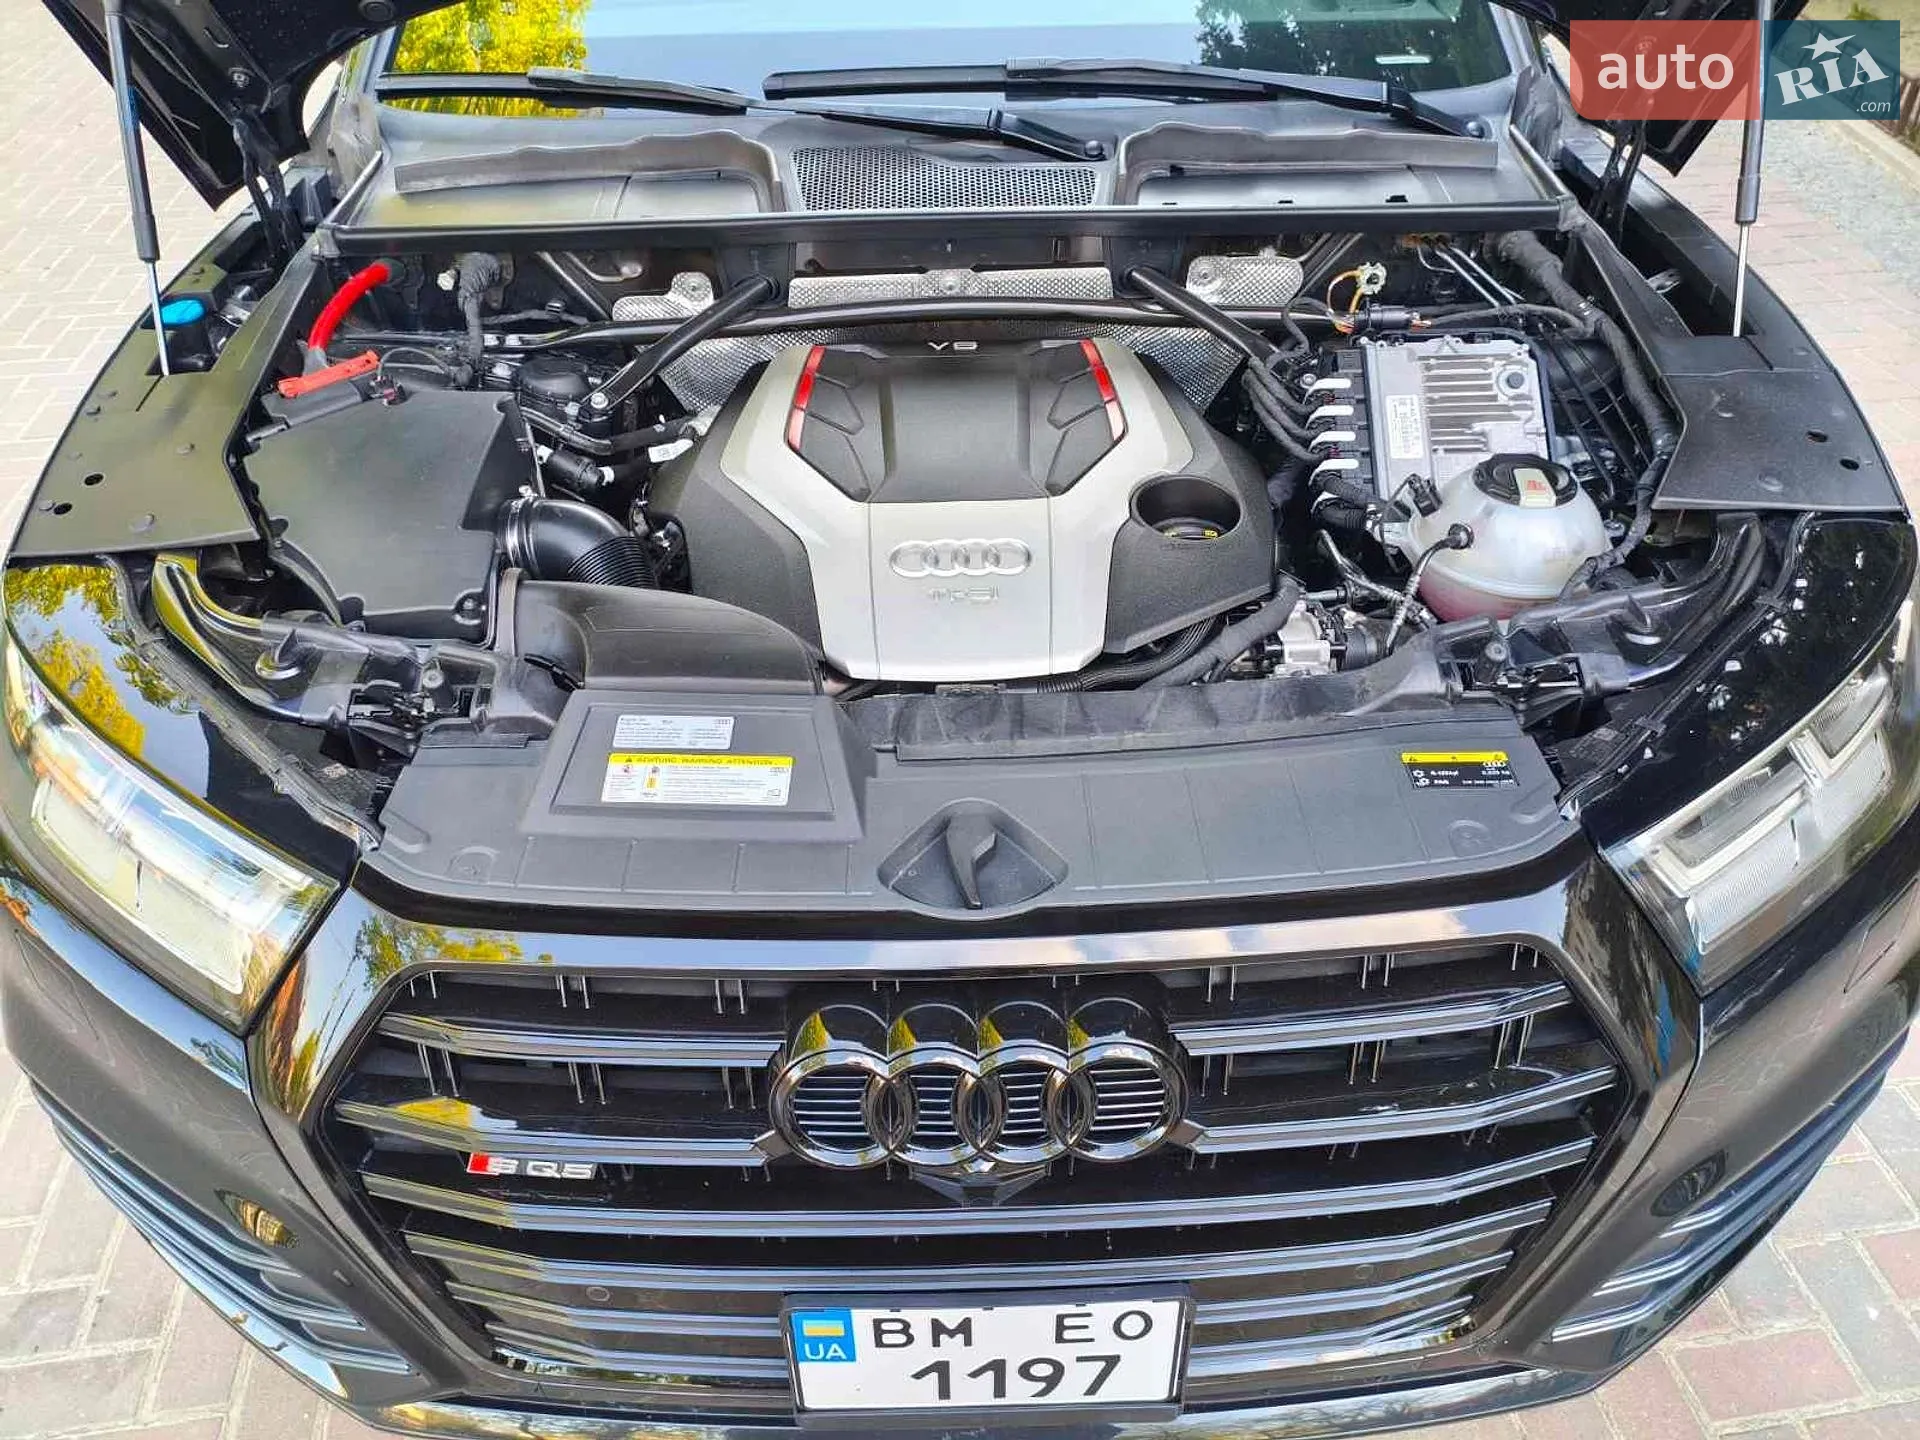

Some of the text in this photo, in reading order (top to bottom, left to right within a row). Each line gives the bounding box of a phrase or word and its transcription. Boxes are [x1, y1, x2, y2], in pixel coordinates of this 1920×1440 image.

[872, 1309, 1153, 1348] BM EO
[805, 1343, 847, 1361] UA
[910, 1354, 1121, 1400] 1197
